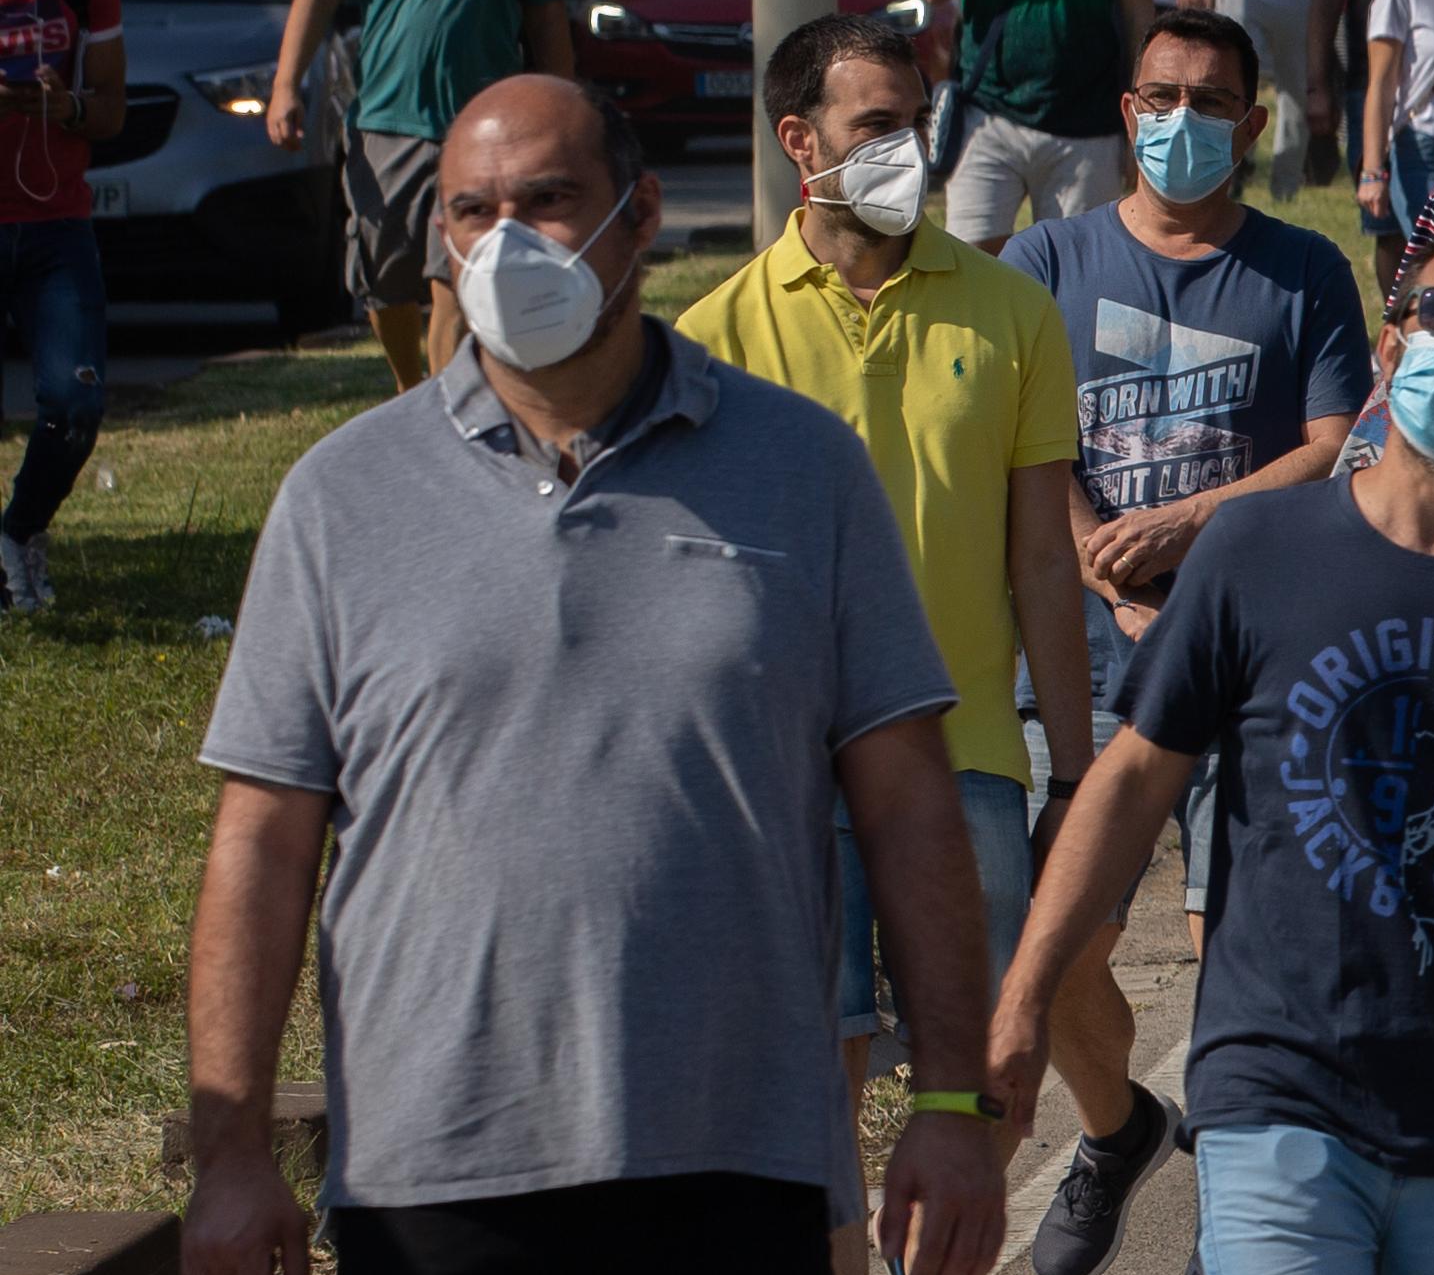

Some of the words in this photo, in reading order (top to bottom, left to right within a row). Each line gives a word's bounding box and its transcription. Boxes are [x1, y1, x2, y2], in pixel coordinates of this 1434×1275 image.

[1079, 380, 1162, 426] BORN
[1167, 362, 1250, 413] WITH
[1157, 453, 1244, 499] LUCK
